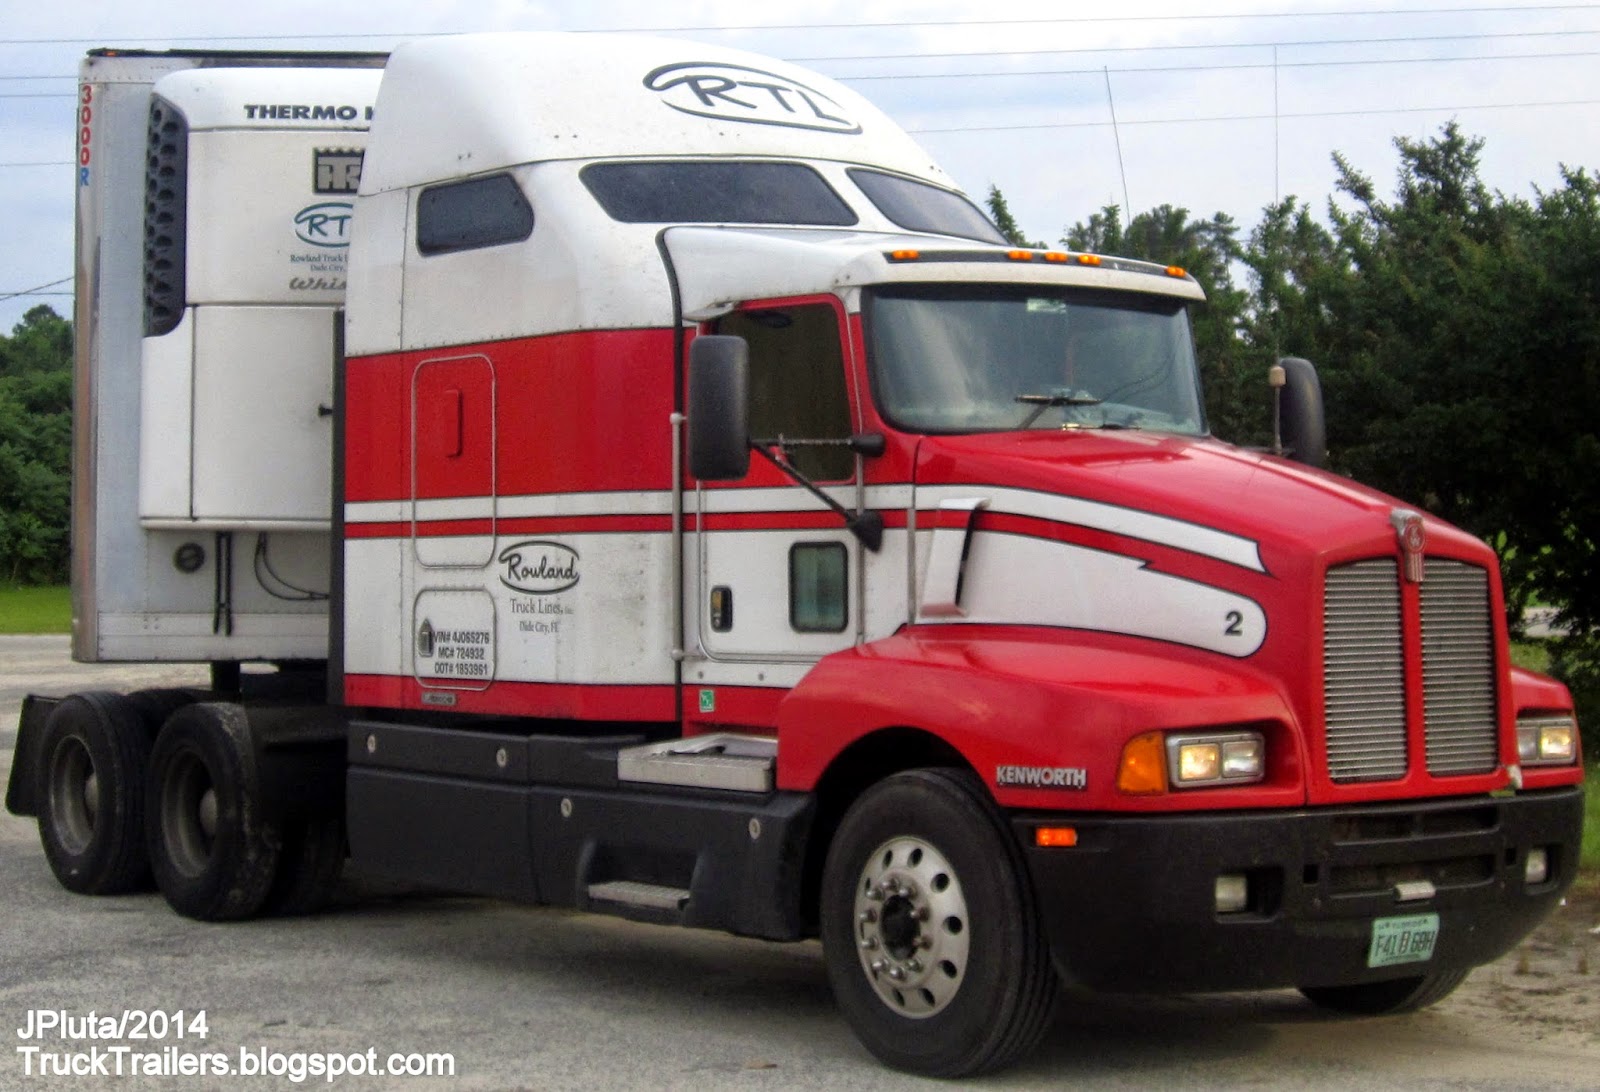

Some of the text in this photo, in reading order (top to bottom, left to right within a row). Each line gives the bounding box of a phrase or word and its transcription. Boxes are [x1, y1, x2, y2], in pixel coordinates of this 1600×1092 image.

[662, 74, 852, 126] RTL
[244, 104, 358, 120] THERMO
[506, 552, 578, 581] Rowland
[510, 598, 535, 613] Truck
[1224, 611, 1243, 636] 2
[438, 647, 454, 658] MC#
[996, 766, 1087, 787] KENWORTH
